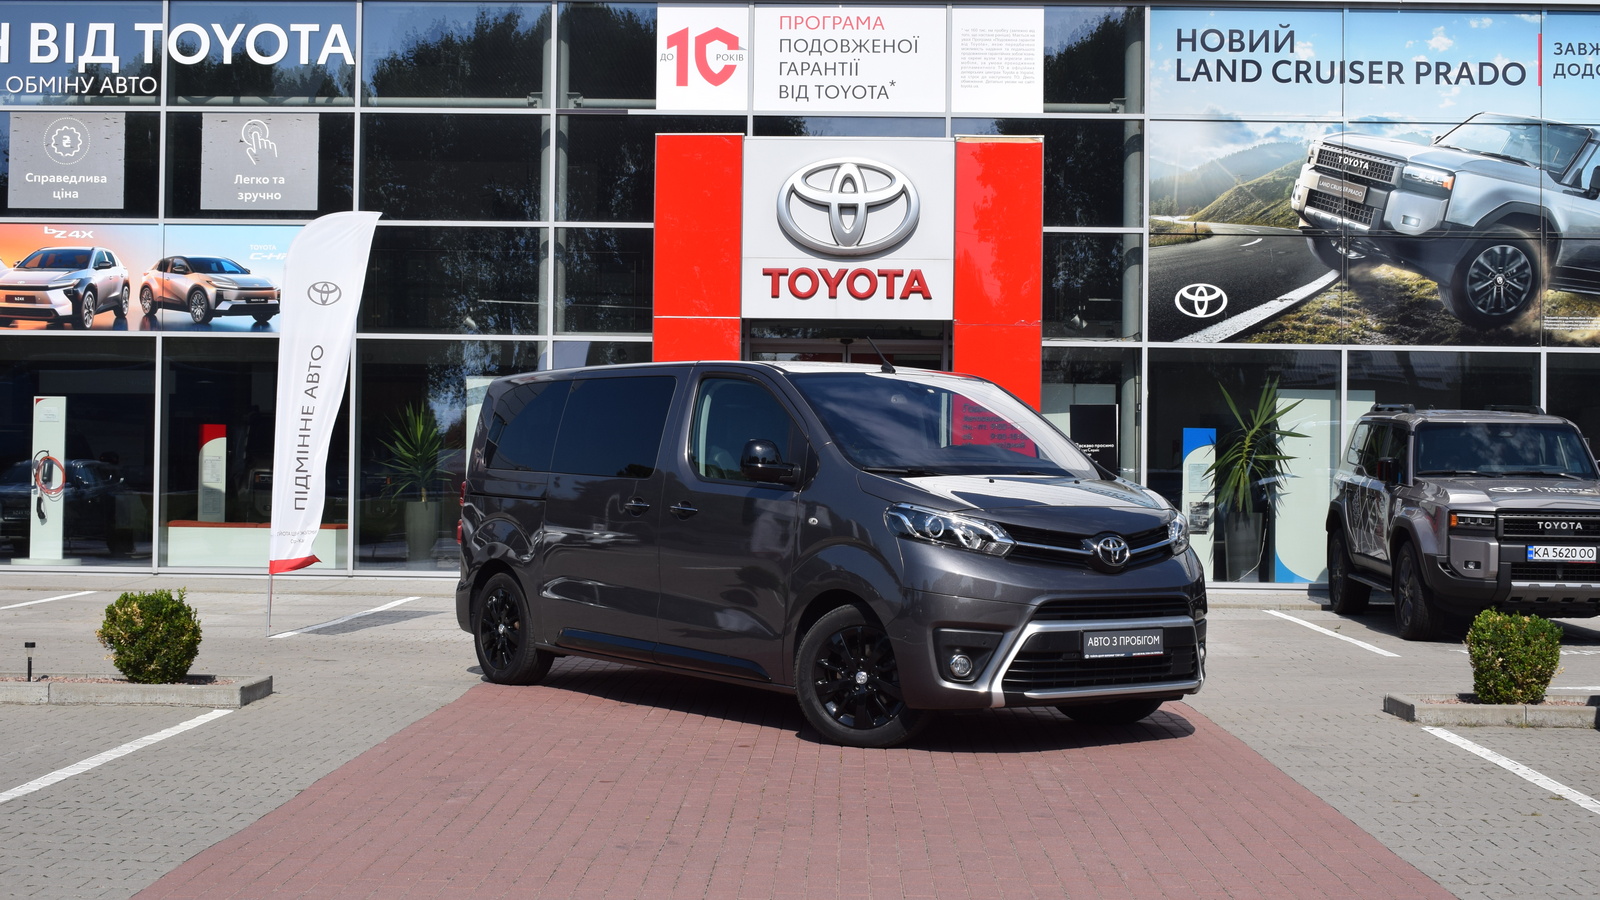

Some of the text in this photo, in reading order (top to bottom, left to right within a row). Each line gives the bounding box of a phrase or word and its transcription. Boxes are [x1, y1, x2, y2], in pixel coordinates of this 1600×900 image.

[779, 15, 885, 31] ПРОГРАМА
[779, 35, 919, 55] ПОДОВЖЕНОЇ
[1176, 23, 1296, 53] НОВИЙ
[30, 22, 120, 73] ВІД
[134, 23, 356, 66] TOYOTA
[659, 53, 674, 62] ДО
[716, 53, 744, 61] РОКІВ
[779, 58, 859, 77] ГАРАНТІЇ
[1176, 58, 1527, 87] LAND CRUISER PRADO
[6, 76, 157, 95] ОБМІНУ АВТО
[778, 84, 810, 102] ВІД
[1338, 156, 1369, 170] TOYOTA
[25, 172, 108, 185] Справедлива
[234, 173, 285, 185] Легко та
[1318, 180, 1330, 188] LAND
[53, 188, 79, 200] ціна
[237, 190, 282, 202] зручно
[762, 267, 932, 300] TOYOTA
[294, 344, 324, 511] ПІДМІННЕ АВТО
[1537, 521, 1583, 530] TOYOTA
[1534, 547, 1550, 557] KA
[1552, 548, 1577, 558] 5620
[1579, 548, 1595, 558] OO
[1087, 636, 1111, 647] АВТО
[1119, 635, 1160, 646] ПРОБІГОМ
